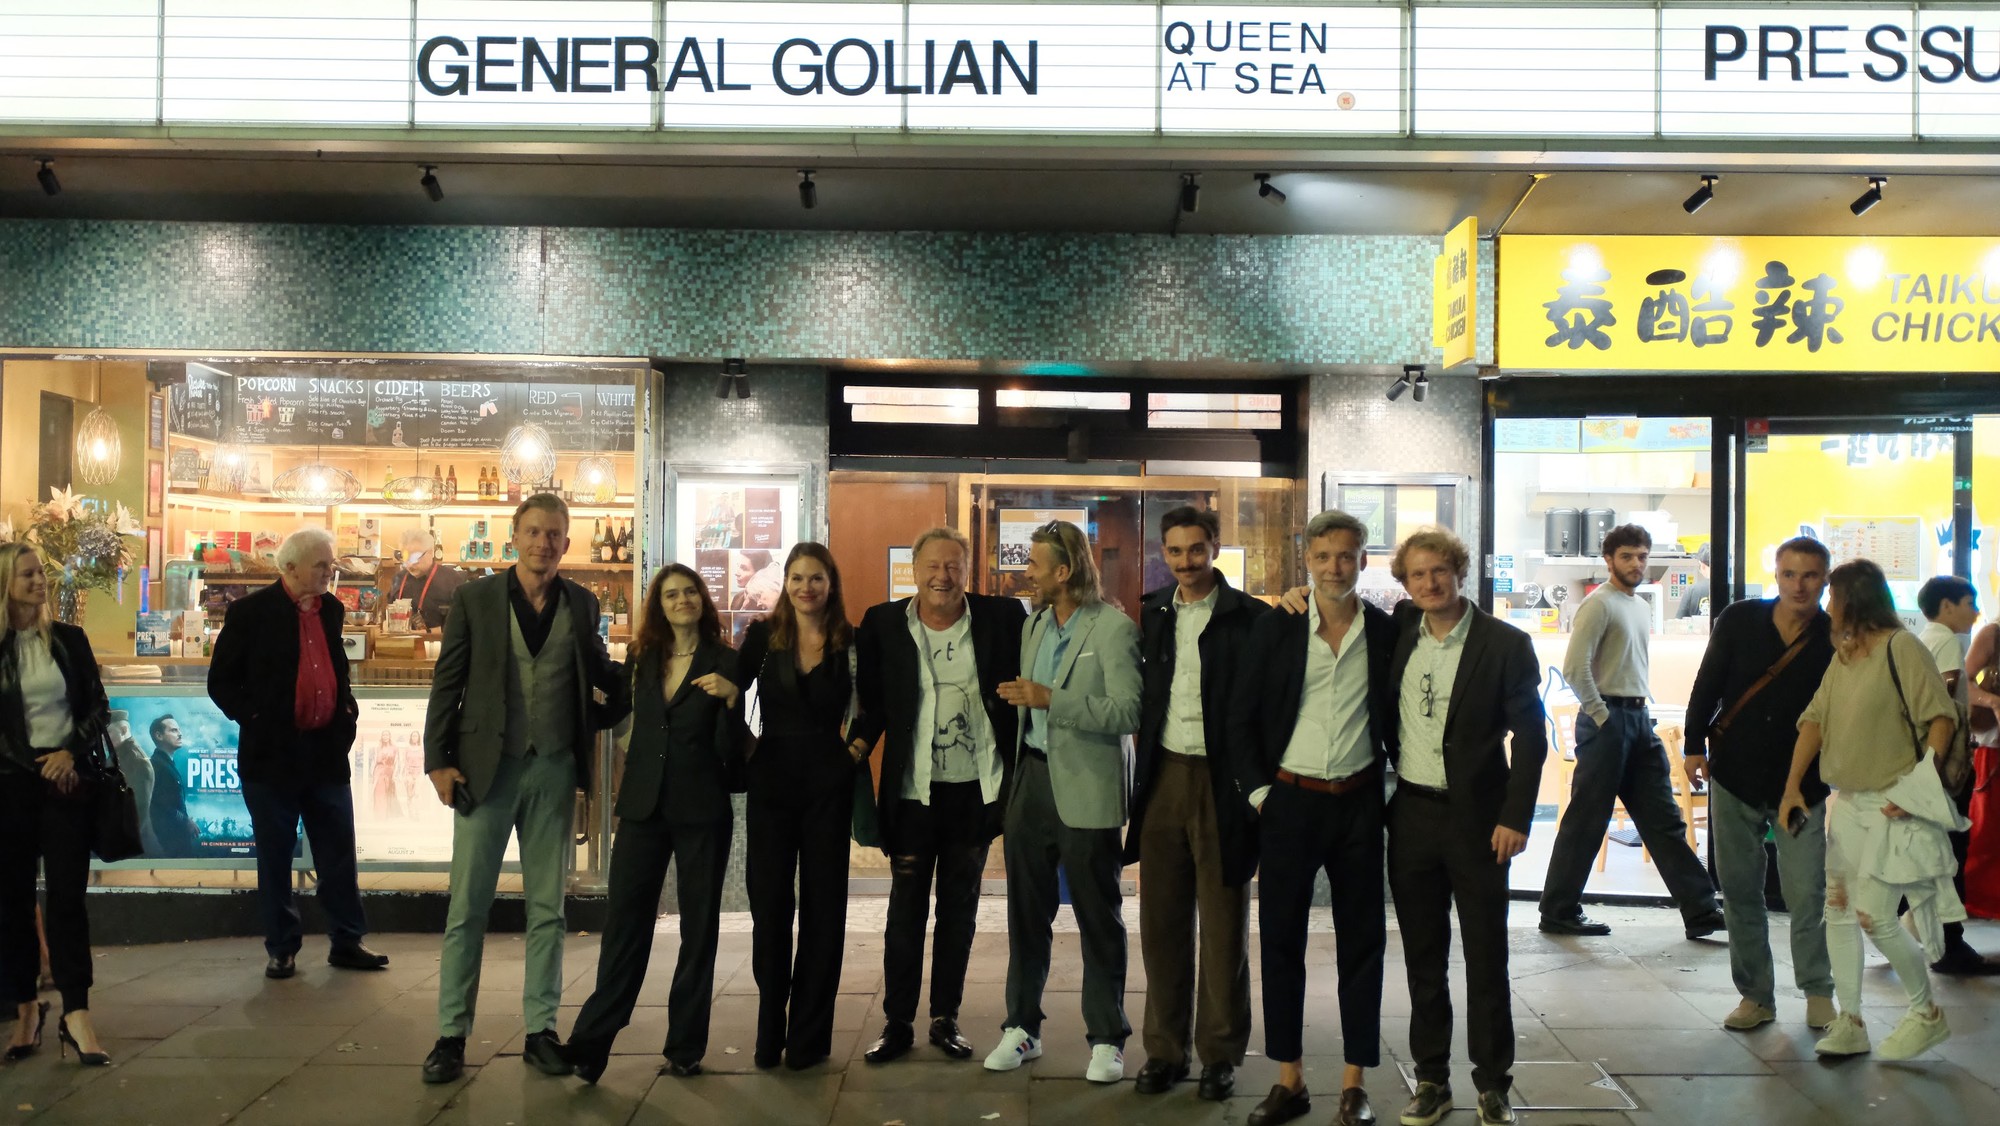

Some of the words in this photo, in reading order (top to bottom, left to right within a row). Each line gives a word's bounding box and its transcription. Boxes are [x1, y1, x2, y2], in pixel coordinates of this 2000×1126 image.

[1164, 20, 1327, 57] QUEEN
[1704, 24, 2000, 83] PRESSU
[417, 36, 751, 96] GENERAL
[772, 38, 1038, 96] GOLIAN
[1167, 62, 1216, 92] AT
[1235, 62, 1327, 94] SEA
[1542, 260, 1845, 353] 泰酷辣
[1872, 311, 2000, 343] CHICK
[237, 377, 296, 392] POPCORN
[238, 394, 255, 404] Fresh
[280, 397, 305, 406] Popcorn
[309, 378, 364, 394] SNACKS
[375, 381, 425, 397] CIDER
[441, 383, 491, 398] BEERS
[528, 389, 557, 405] RED
[187, 758, 240, 789] PRES
